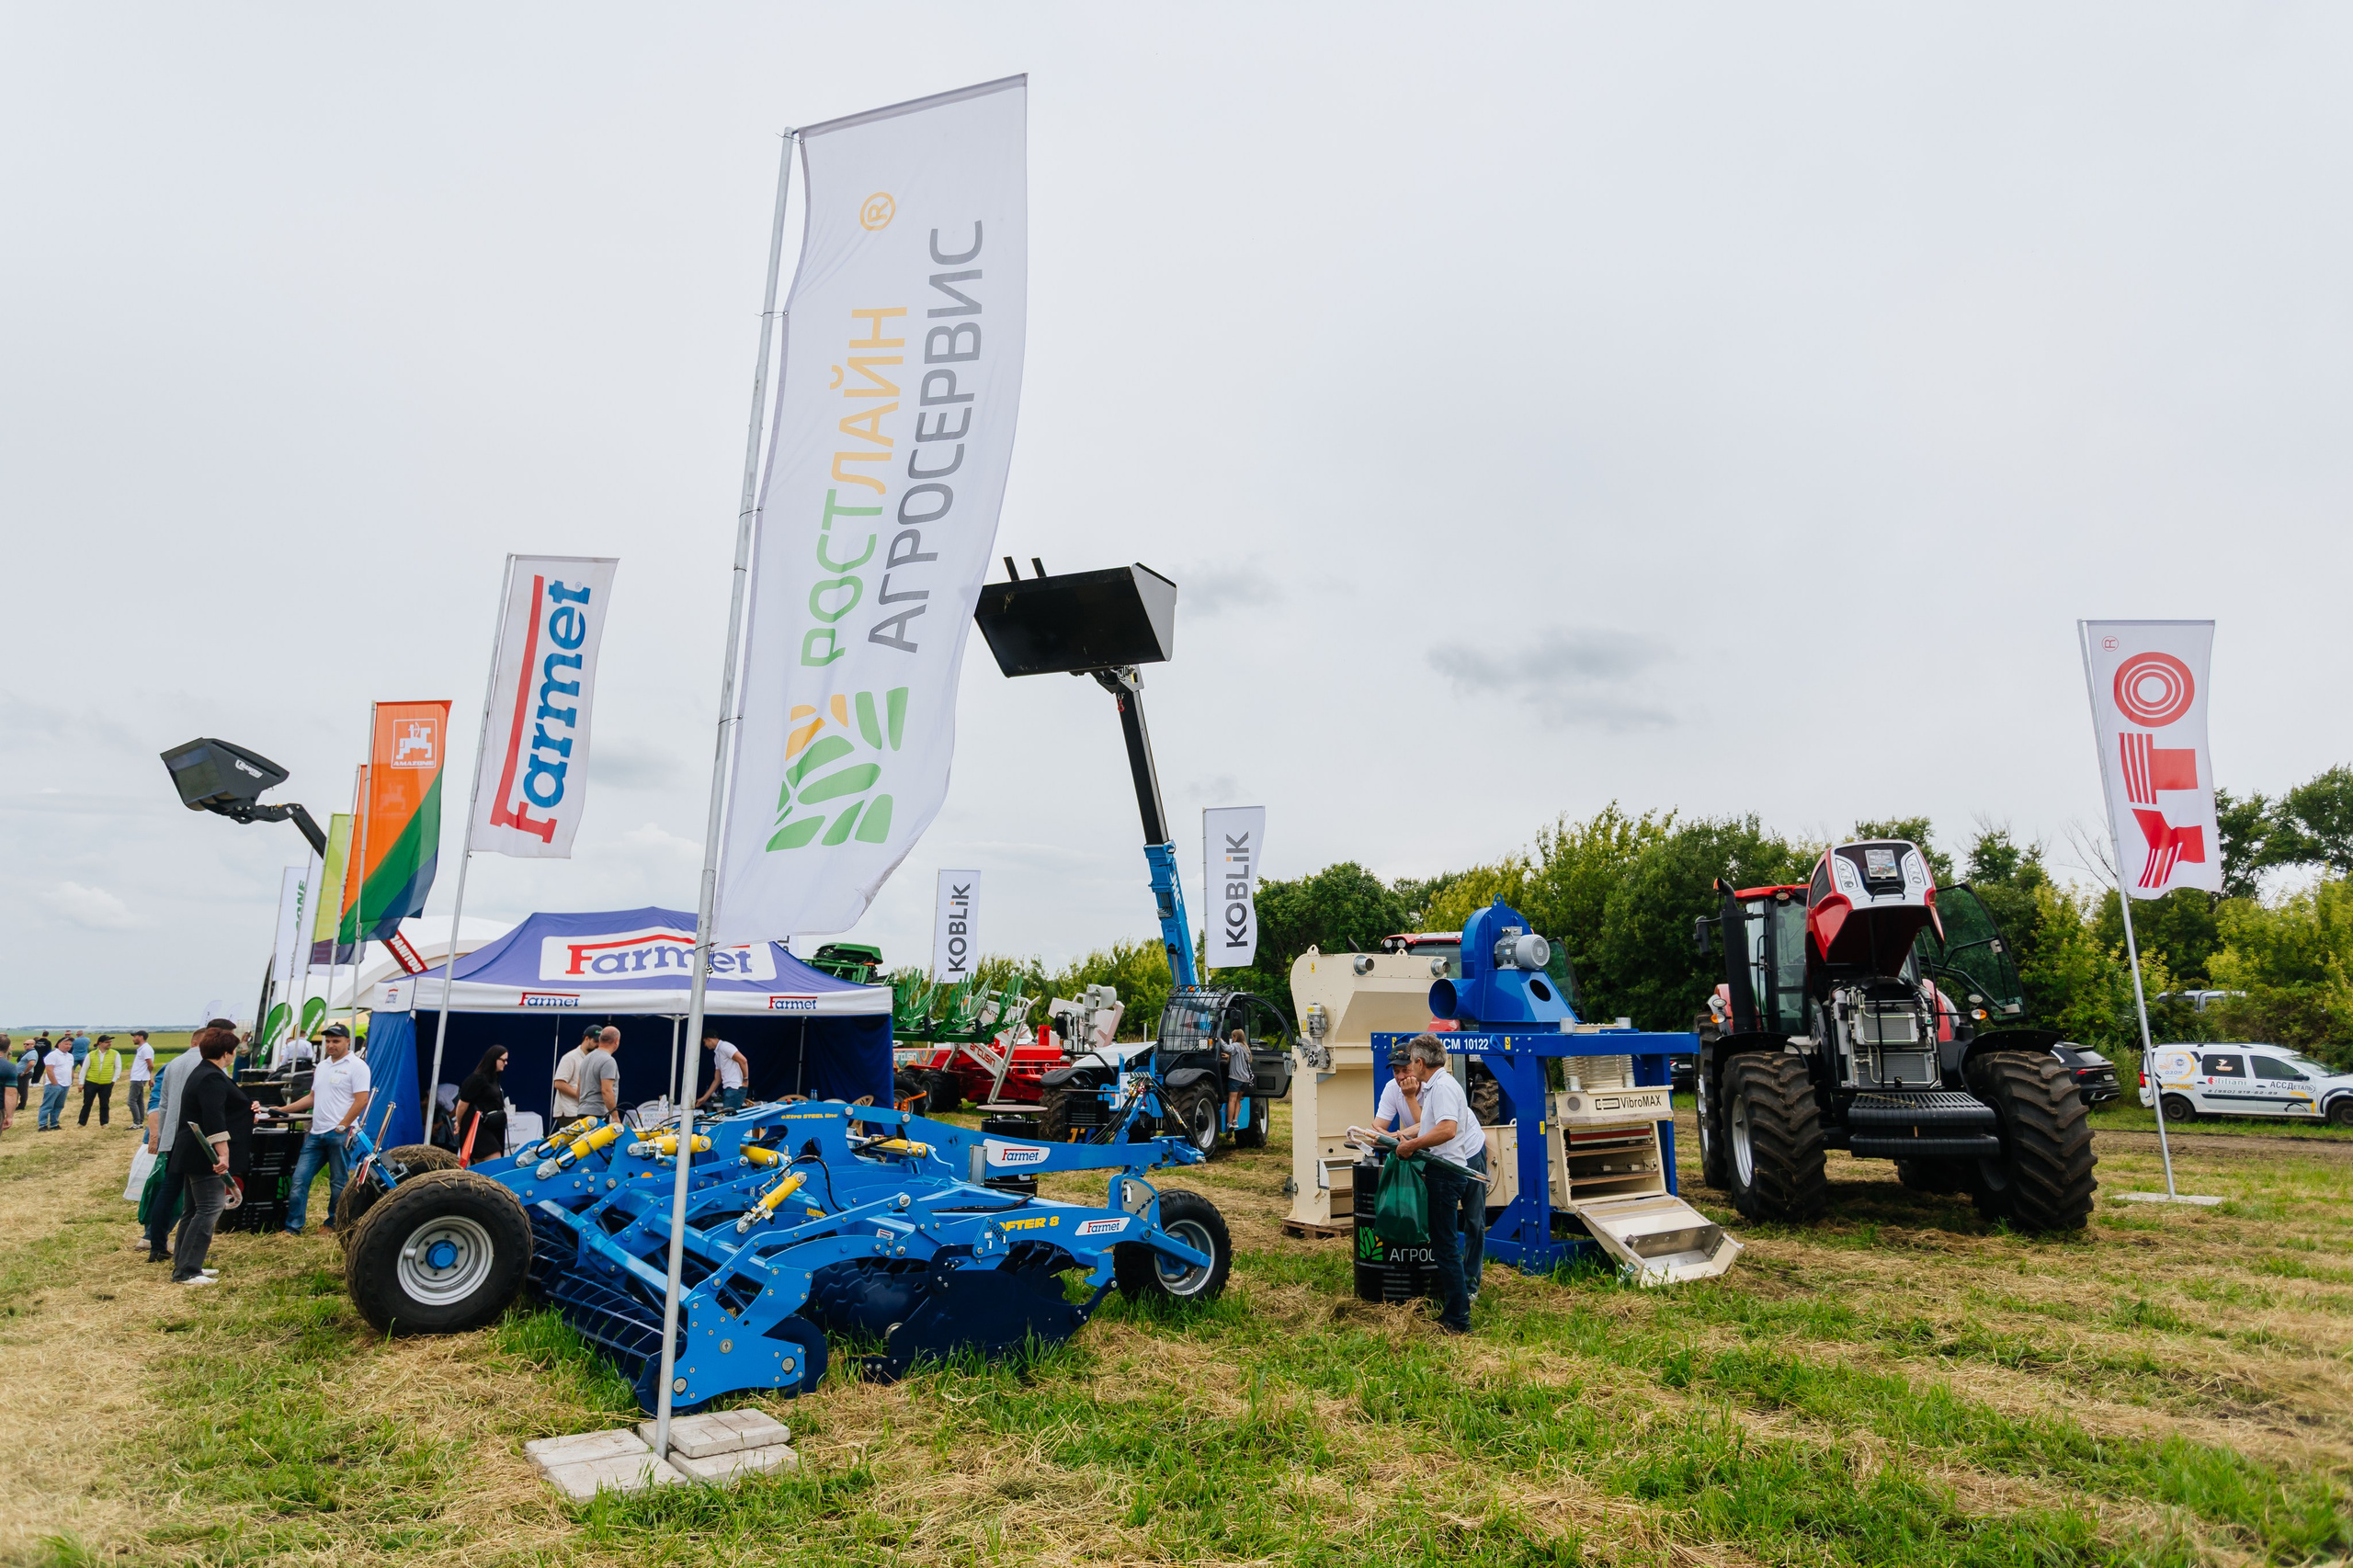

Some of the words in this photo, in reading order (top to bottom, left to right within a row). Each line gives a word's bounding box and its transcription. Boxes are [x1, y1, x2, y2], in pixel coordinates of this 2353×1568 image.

[868, 220, 983, 653] АГРОСЕРВИС
[801, 307, 907, 667] РОСТЛАЙН
[490, 574, 591, 844] Farmet
[564, 934, 754, 976] Farmet
[518, 992, 580, 1007] Farmet
[768, 995, 818, 1010] Farmet
[1463, 1038, 1489, 1050] 10122
[1620, 1095, 1662, 1108] VibroMAX
[1002, 1149, 1040, 1162] Farmet
[1049, 1216, 1060, 1227] 8
[1087, 1220, 1120, 1233] Farmet
